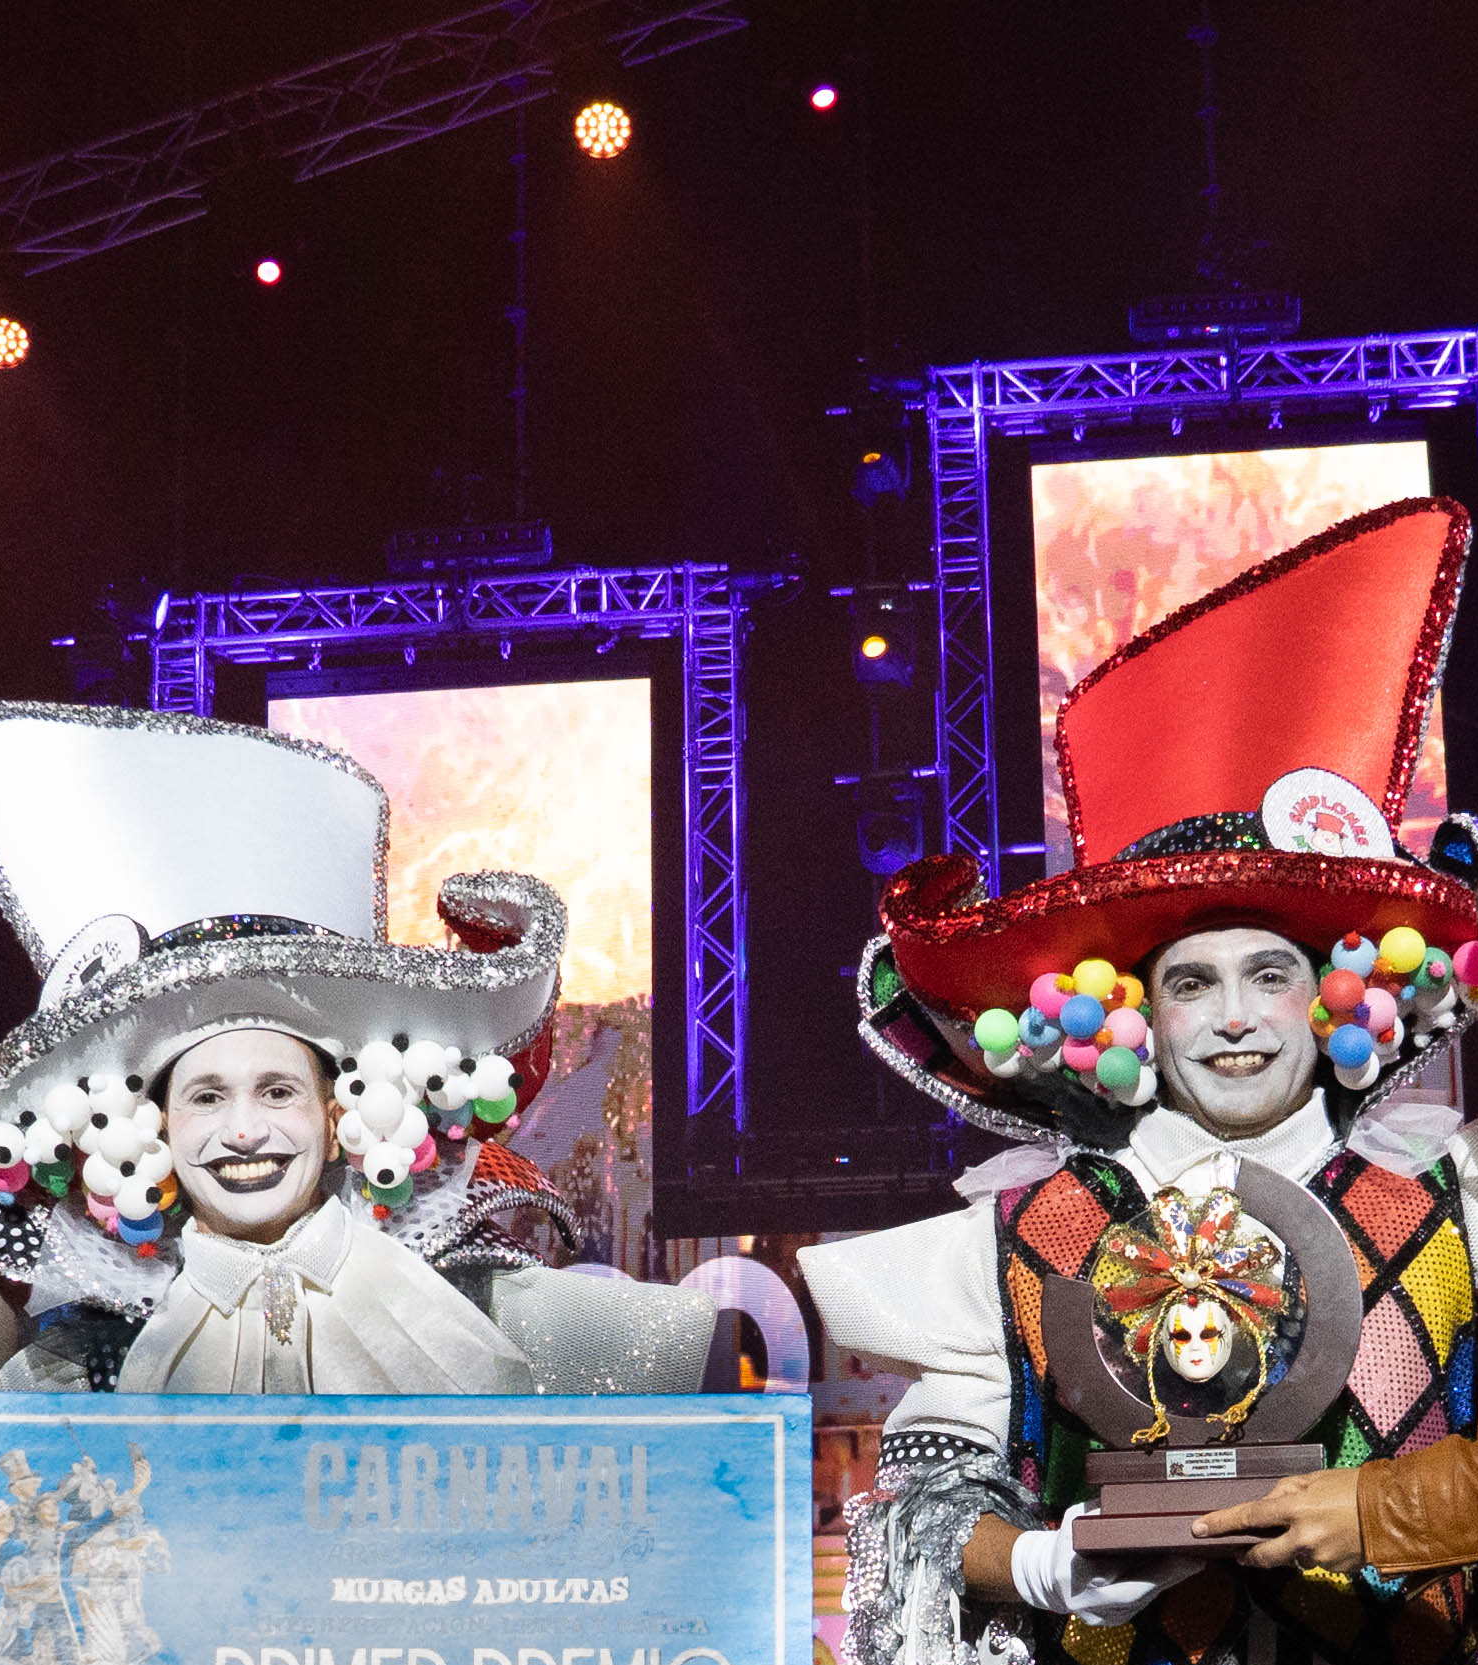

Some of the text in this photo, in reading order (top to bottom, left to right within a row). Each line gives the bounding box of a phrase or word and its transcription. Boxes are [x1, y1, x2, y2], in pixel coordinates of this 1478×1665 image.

[1289, 795, 1369, 847] SIMPLONES
[304, 1441, 657, 1530] CARNAVAL
[331, 1576, 630, 1606] MURGAS ADULTAS
